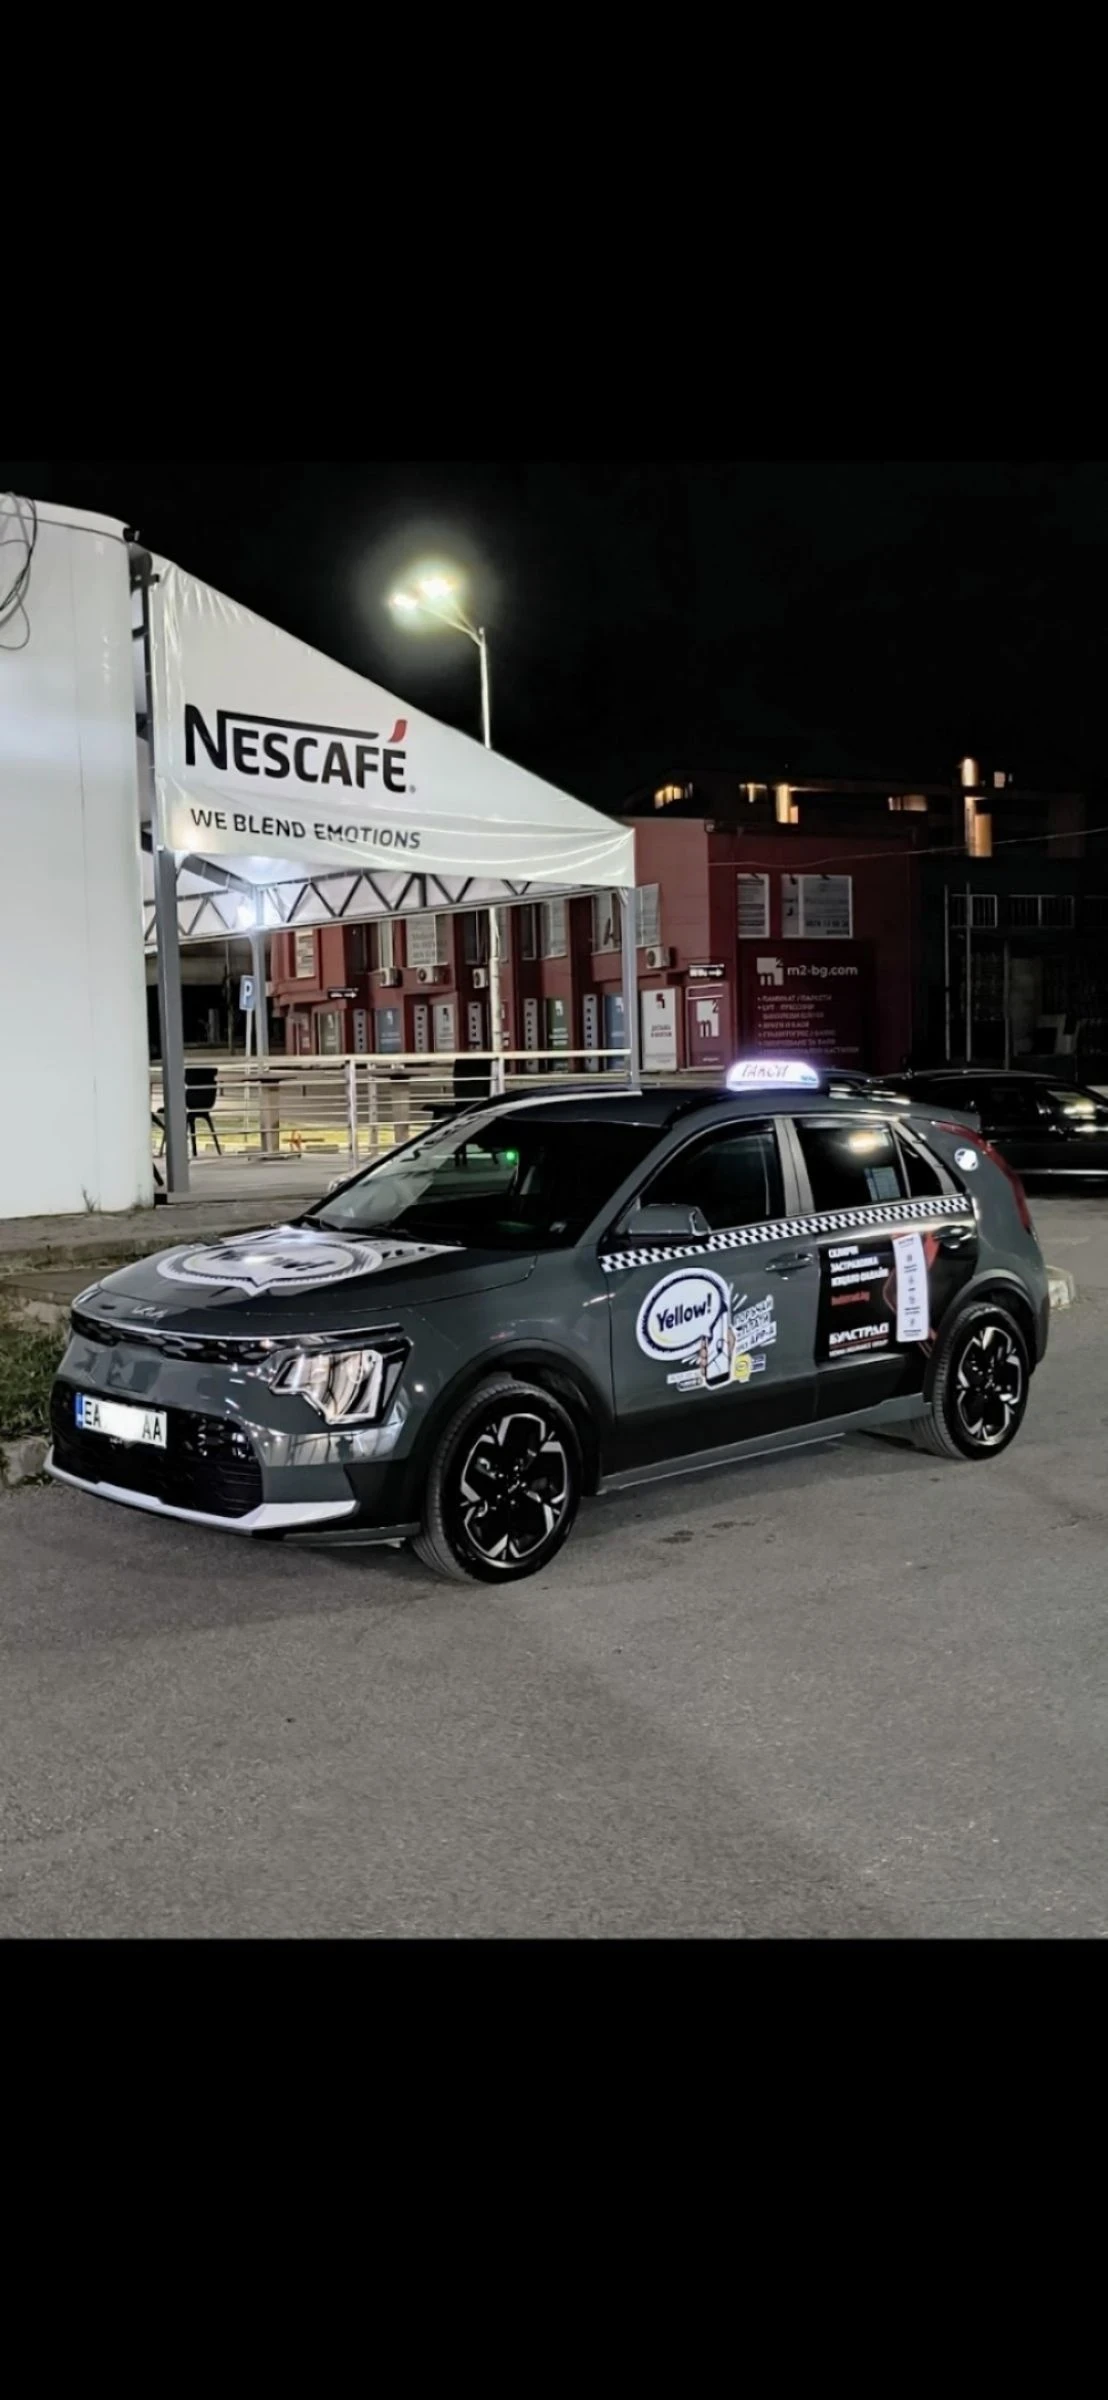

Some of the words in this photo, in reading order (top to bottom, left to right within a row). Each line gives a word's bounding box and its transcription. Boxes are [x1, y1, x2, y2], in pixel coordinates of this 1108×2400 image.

[184, 703, 407, 793] NESCAFÉ
[190, 808, 227, 830] WE
[233, 813, 306, 839] BLEND
[313, 822, 421, 849] EMOTIONS
[786, 965, 859, 978] m2-bg.com
[656, 1292, 712, 1333] Yellow!
